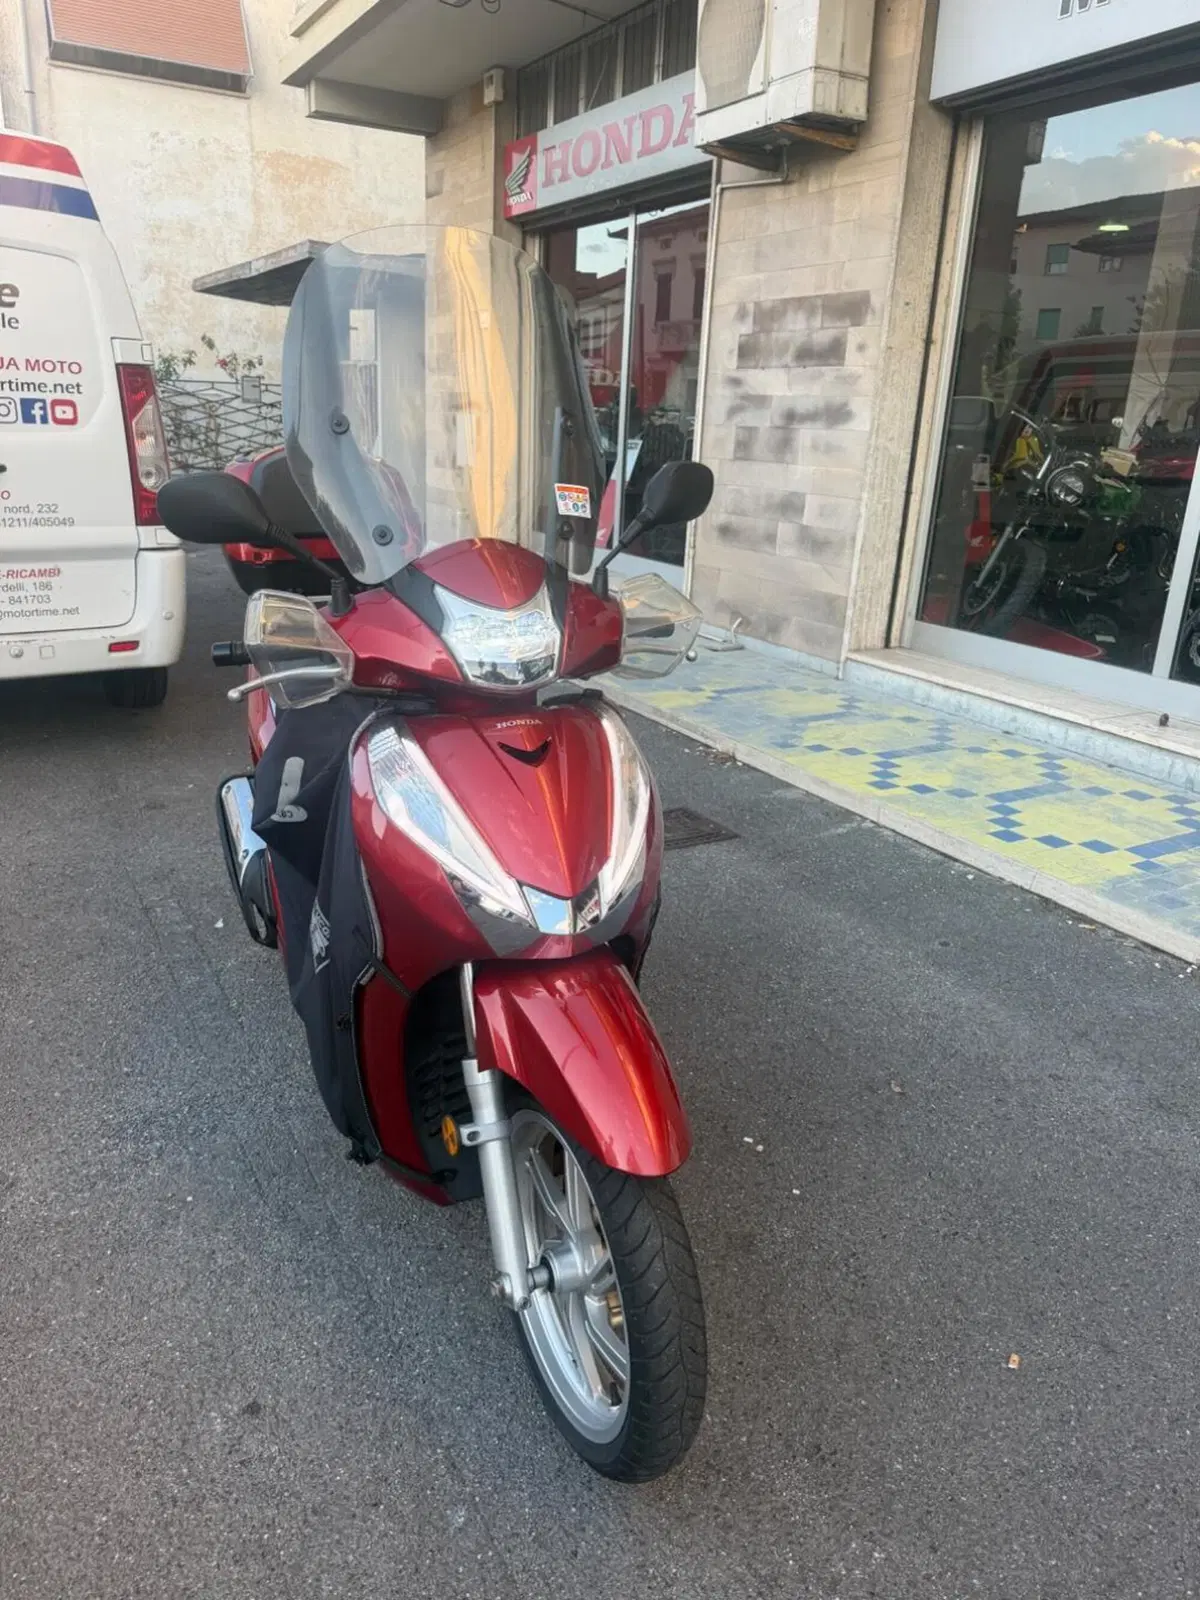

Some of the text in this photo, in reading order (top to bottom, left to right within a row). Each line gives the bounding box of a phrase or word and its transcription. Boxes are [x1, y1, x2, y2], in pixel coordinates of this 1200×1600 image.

[541, 92, 696, 188] HONDA
[0, 283, 20, 308] e
[1, 312, 20, 329] le
[25, 358, 83, 375] MOTO
[0, 378, 83, 394] rtime.net
[37, 503, 59, 514] 232
[0, 582, 28, 592] delli,
[8, 594, 52, 605] 841703
[495, 719, 542, 728] HONDA
